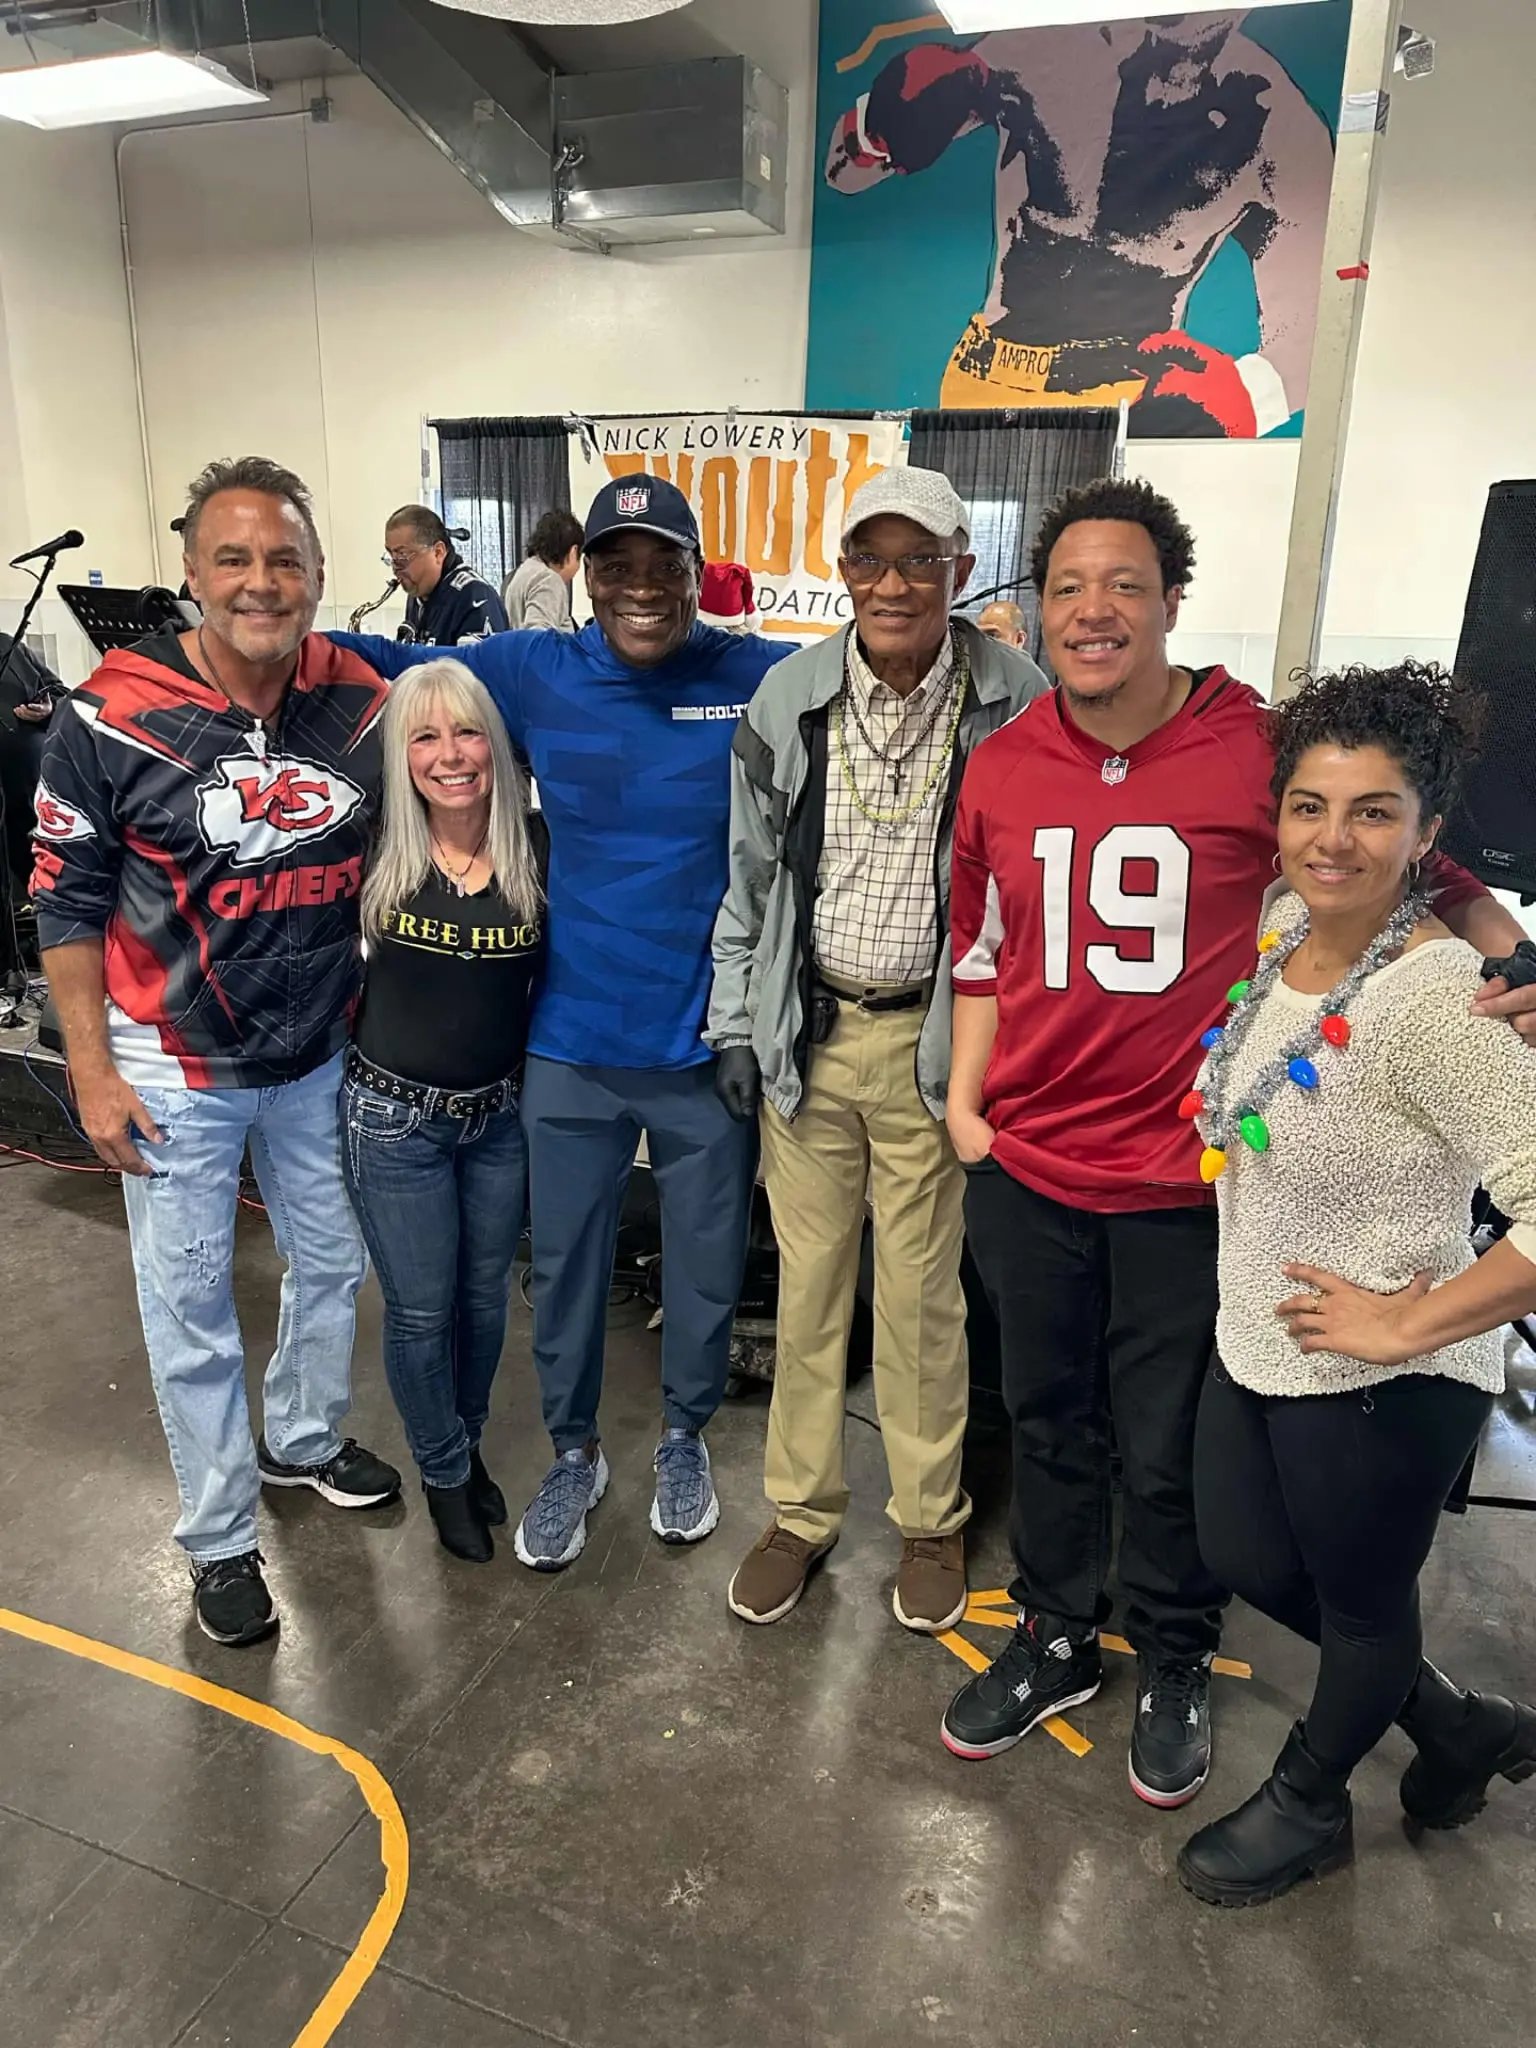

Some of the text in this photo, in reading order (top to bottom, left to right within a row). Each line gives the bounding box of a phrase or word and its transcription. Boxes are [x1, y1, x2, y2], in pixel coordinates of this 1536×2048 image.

[997, 344, 1050, 376] AMPRO
[604, 424, 809, 451] NICK LOWERY
[620, 495, 646, 510] NFL
[705, 703, 749, 720] COLT
[232, 768, 334, 833] KC
[207, 855, 363, 920] CHIEFS
[1032, 823, 1192, 996] 19
[381, 909, 462, 947] FREE
